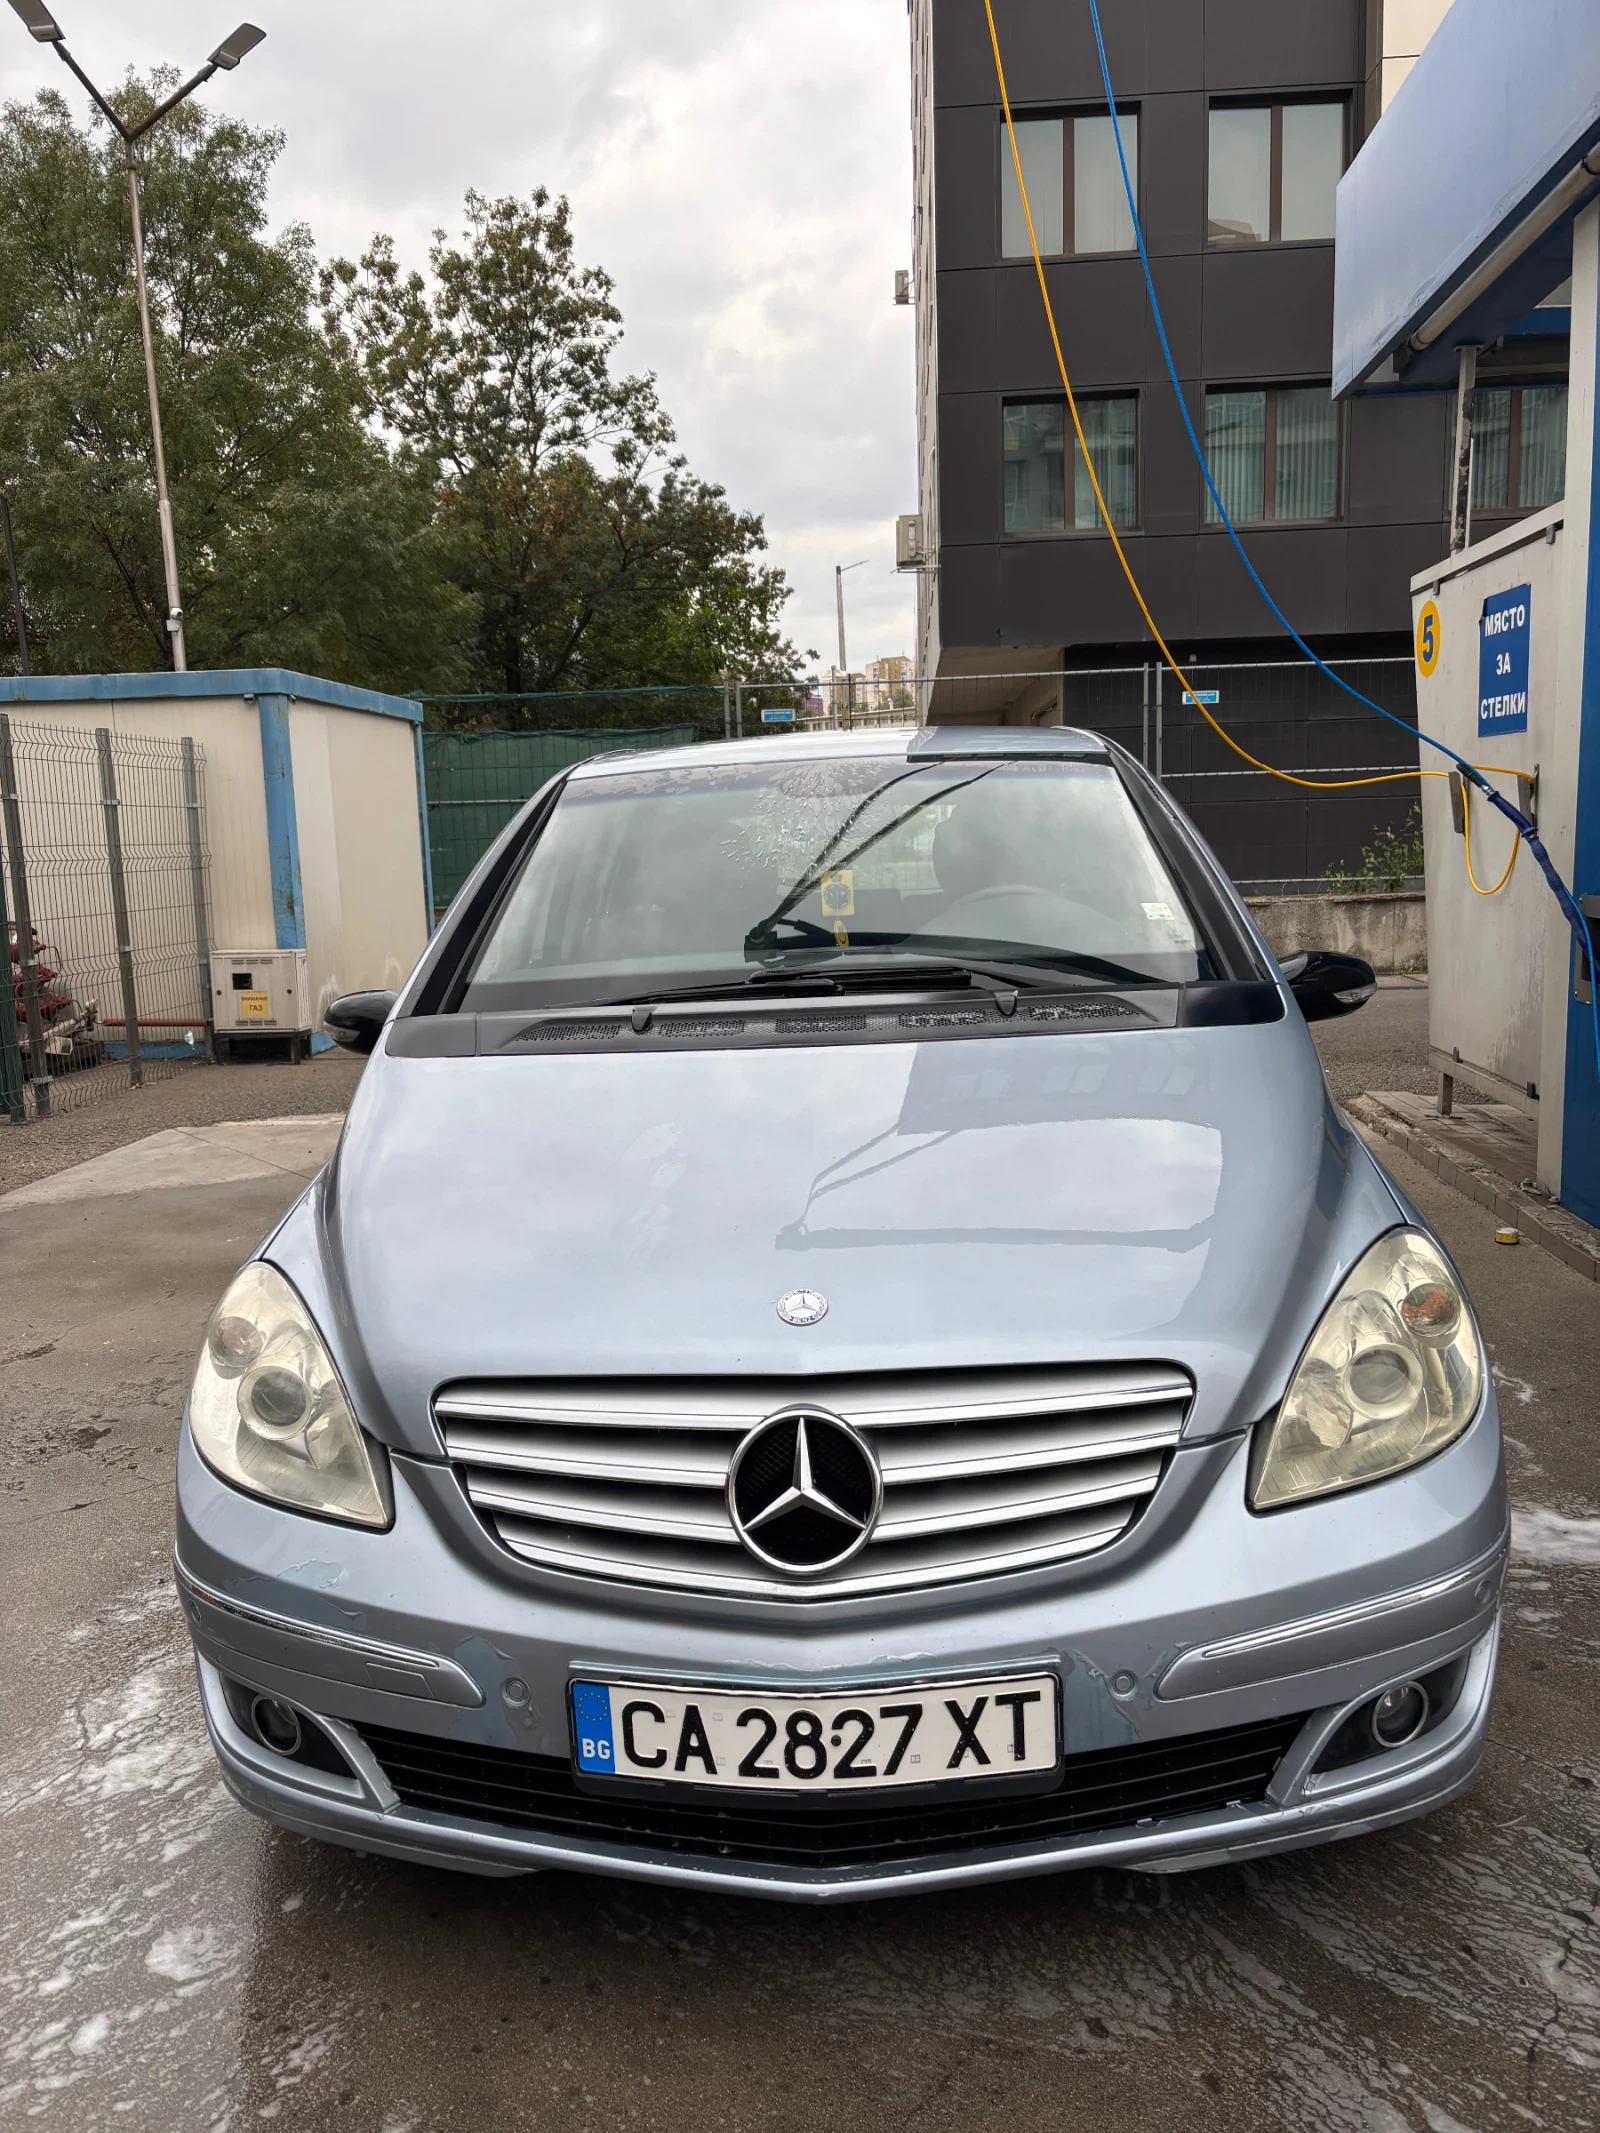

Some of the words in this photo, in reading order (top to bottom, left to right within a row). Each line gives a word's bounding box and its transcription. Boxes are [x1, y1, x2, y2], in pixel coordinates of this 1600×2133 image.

[1484, 604, 1526, 637] МЯСТО
[1422, 614, 1434, 663] 5
[1496, 652, 1511, 676] ЗА
[1480, 691, 1526, 720] СТЕЛКИ
[249, 1004, 263, 1012] ГАЗ
[582, 1738, 612, 1760] BG
[621, 1699, 718, 1776] CA
[735, 1708, 923, 1780] 2827
[945, 1691, 1041, 1769] XT
